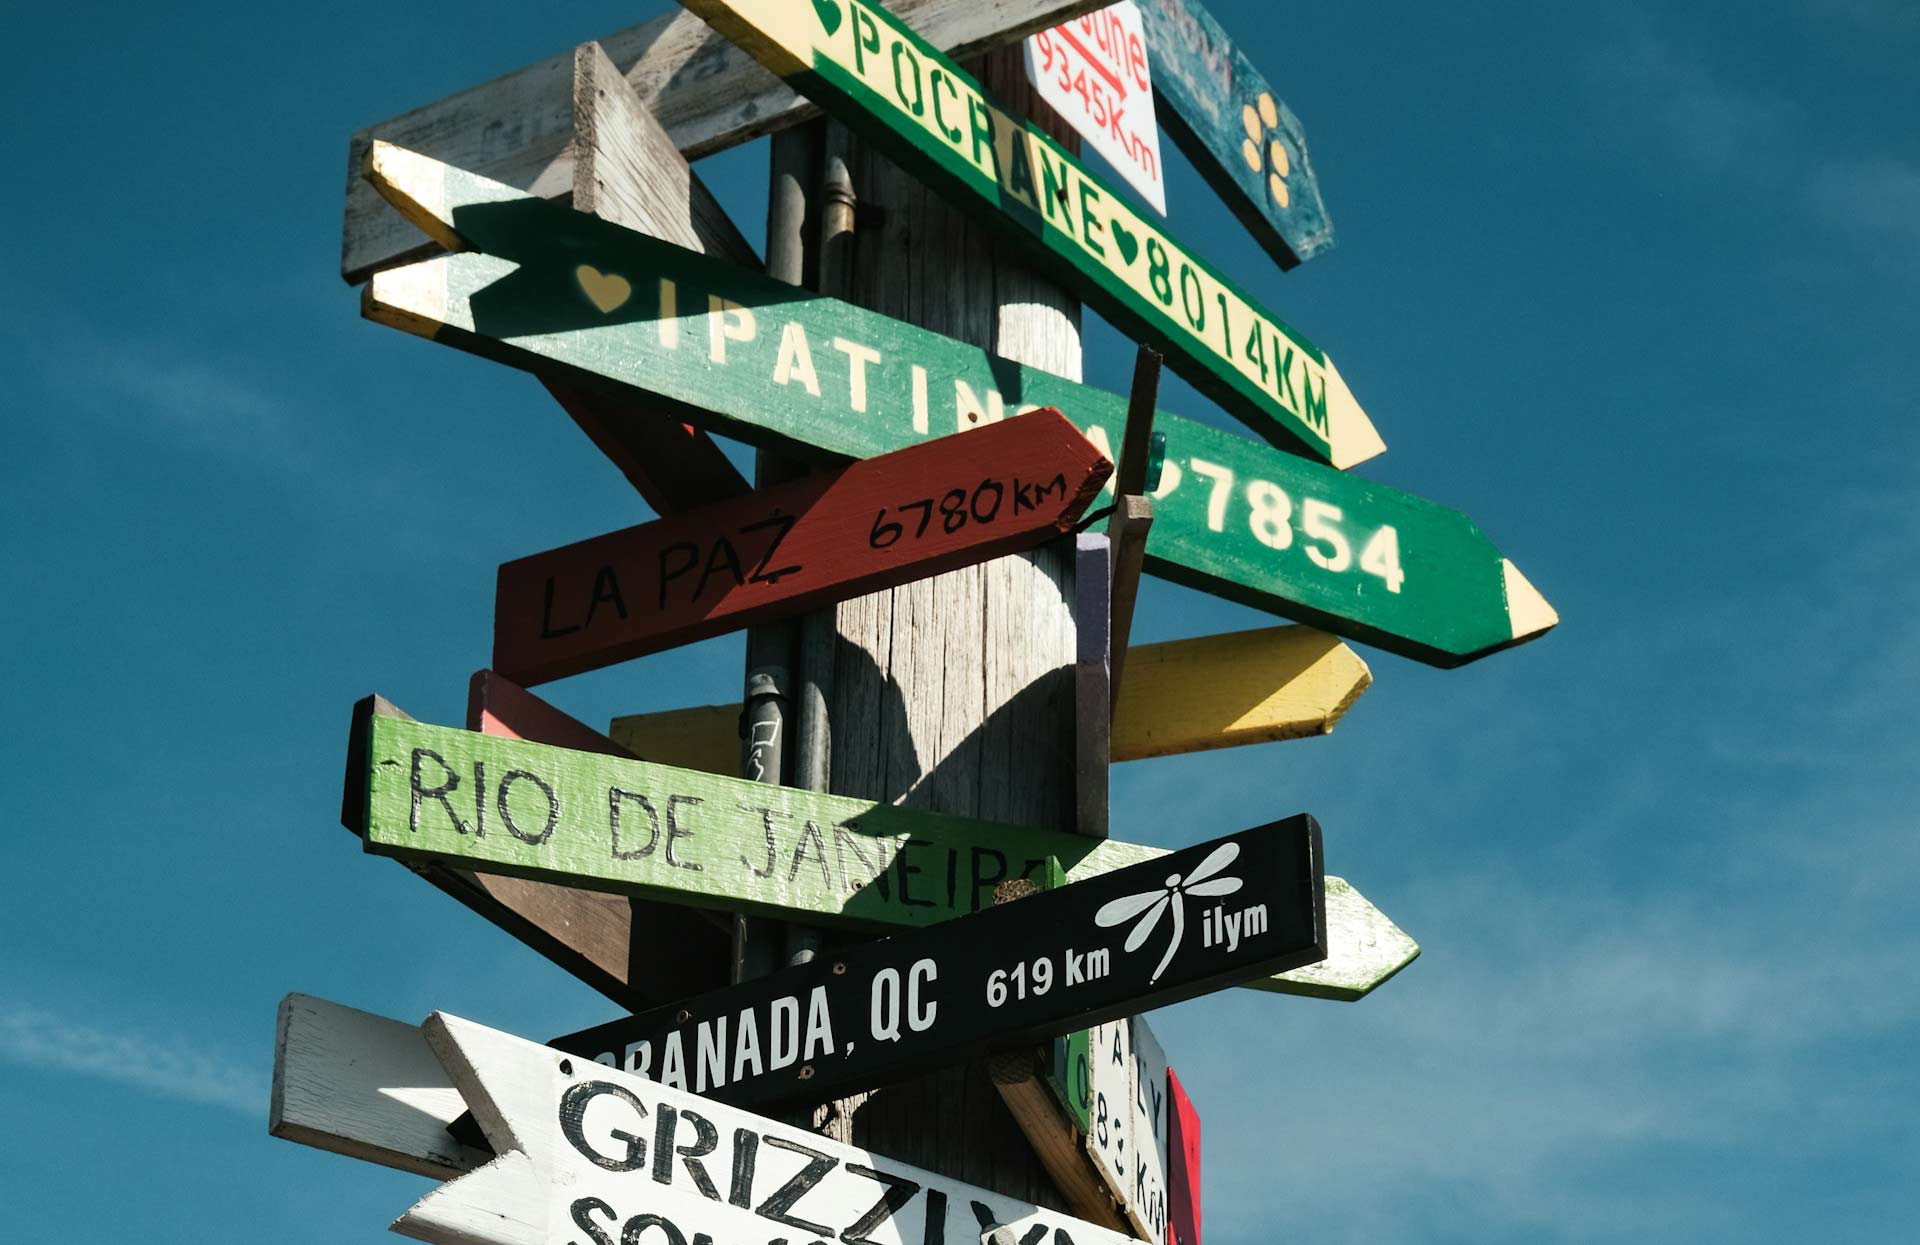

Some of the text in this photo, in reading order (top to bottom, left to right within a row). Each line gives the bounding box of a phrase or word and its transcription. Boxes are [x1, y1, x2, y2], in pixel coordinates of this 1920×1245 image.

[851, 12, 1105, 259] POCRANE
[1146, 237, 1329, 438] 8014KM
[659, 279, 1404, 594] IPATINA 7854
[539, 574, 628, 640] LA
[658, 514, 803, 610] PAZ
[410, 747, 560, 845] RIO
[609, 786, 704, 871] DE
[1202, 904, 1268, 953] ilym
[593, 947, 1110, 1094] RANADA, QC 619 km
